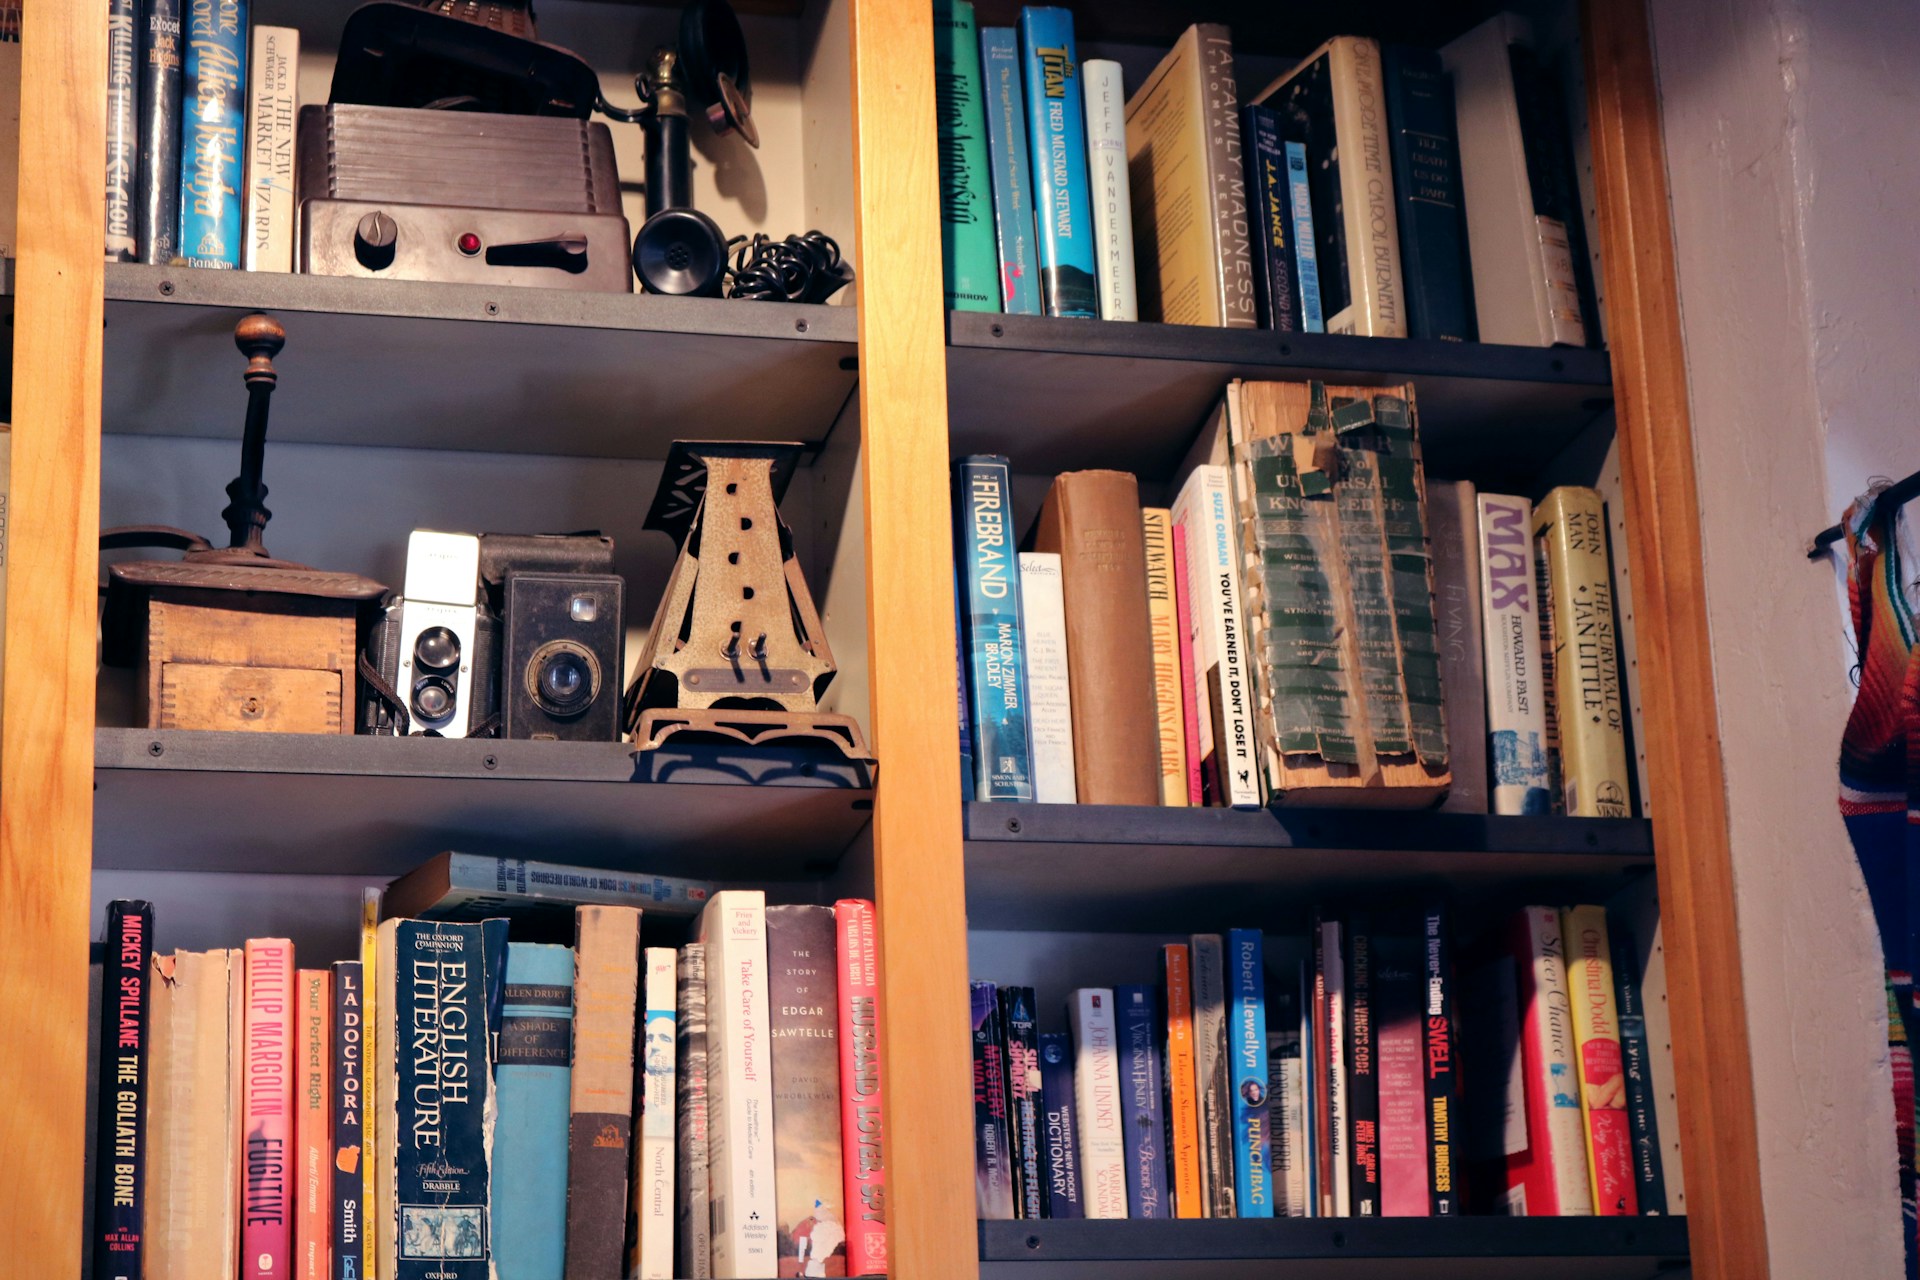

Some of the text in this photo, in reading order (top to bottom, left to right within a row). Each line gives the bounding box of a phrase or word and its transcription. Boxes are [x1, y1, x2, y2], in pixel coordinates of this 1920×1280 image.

[110, 14, 132, 84] KILLING
[150, 16, 180, 34] Exocet
[155, 34, 175, 51] Jack
[149, 48, 180, 68] Higgins
[264, 35, 275, 89] SCHWAGER
[276, 55, 287, 78] JACK
[1036, 43, 1069, 99] TITAN
[1065, 61, 1075, 78] THE
[257, 93, 273, 170] MARKET
[275, 96, 292, 180] THE NEW
[1353, 41, 1382, 172] ONE MORE TIME
[187, 124, 238, 218] Volodya
[943, 132, 978, 225] Anniversary
[1048, 101, 1072, 239] FRED MUSTARD STEWART
[1102, 76, 1121, 310] JEFF VANDERMEER
[1209, 48, 1236, 309] THOMAS KENEALLY
[1220, 49, 1255, 313] A FAMILY MADNESS
[1265, 159, 1278, 188] J.A.
[1270, 191, 1284, 248] JANCE
[188, 256, 233, 270] Random
[1368, 179, 1396, 324] CAROL BURNETT
[1213, 492, 1224, 521] SUZE
[1568, 512, 1584, 550] MAN
[1585, 510, 1600, 556] JOHN
[972, 481, 1007, 599] FIREBRAND
[1144, 513, 1168, 600] STILLWATCH
[1216, 525, 1228, 566] ORMAN
[1485, 502, 1529, 612] MAX
[1151, 614, 1171, 654] MARY
[1220, 573, 1247, 758] YOU'VE EARNED IT, DON'T LOSE IT
[1511, 614, 1529, 715] HOWARD FAST
[1573, 598, 1604, 712] JAN LITTLE
[1594, 581, 1621, 734] THE SURVIVAL OF
[985, 643, 1002, 689] BRADLEY
[998, 623, 1018, 710] MARION ZIMMER
[1155, 662, 1176, 723] HIGGINS
[1160, 727, 1180, 777] CLARK
[531, 870, 617, 891] BOOK WORLD RECORDS
[415, 940, 463, 952] COMPANION
[732, 927, 758, 936] Vickery
[735, 911, 753, 919] Fries
[118, 914, 142, 1049] MICKEY SPILLANE
[1427, 916, 1443, 1015] The Never-Ending
[1582, 928, 1606, 989] Christina
[534, 989, 566, 999] DRURY
[741, 960, 756, 1081] Take Care of Yourself
[782, 1006, 823, 1016] EDGAR
[1241, 941, 1257, 1068] Robert Llewellyn
[1354, 935, 1369, 1075] CRACKING CODE
[1541, 936, 1567, 1057] Sheer Chance
[1590, 992, 1611, 1035] Dodd
[251, 947, 283, 1116] PHILLIP MARGOLIN
[308, 977, 322, 1110] Your Perfect Right
[343, 976, 359, 1125] LA DOCTORA
[413, 960, 441, 1150] LITERATURE
[441, 961, 468, 1104] ENGLISH
[500, 1047, 567, 1059] DIFFERENCE
[519, 1023, 556, 1032] SHADE
[524, 1035, 539, 1044] OF
[771, 1028, 834, 1039] SAWTELLE
[1088, 1021, 1110, 1081] JOHANNA
[1130, 1023, 1146, 1071] VIRGINIA
[1429, 1016, 1449, 1079] SWELL
[851, 996, 886, 1225] HUSBAND, LOVER, SPY
[984, 1044, 1004, 1119] MYSTERY
[1095, 1084, 1115, 1132] LINDSEY
[1133, 1072, 1147, 1109] HENLEY
[1330, 1068, 1341, 1156] we're so famous
[113, 1054, 138, 1208] THE GOLIATH BONE
[984, 1124, 995, 1154] ROBERT
[1179, 1078, 1192, 1196] of Apprentice
[1269, 1062, 1291, 1172] HORSE WHISPERER
[1356, 1120, 1366, 1165] PETER JONES
[1433, 1096, 1450, 1193] TIMOTHY BURGESS
[247, 1139, 283, 1227] FUGITIVE
[308, 1146, 317, 1214] Alberti/Emmons
[416, 1161, 437, 1178] Fifth
[654, 1146, 665, 1217] North Central
[1021, 1101, 1039, 1219] HERITAGE OF FLIGHT
[1048, 1112, 1066, 1196] DICTIONARY
[1061, 1105, 1076, 1203] WEBSTER'S NEW POCKET
[1139, 1144, 1155, 1188] BORDER
[1248, 1118, 1264, 1205] PUNCHBAG
[1365, 1120, 1376, 1183] JAMES GARLOW
[423, 1182, 460, 1190] DRABBLE
[1108, 1163, 1121, 1215] MARRIAGE
[104, 1233, 140, 1242] MAX ALLAN
[109, 1242, 135, 1251] COLLINS
[343, 1200, 357, 1244] Smith
